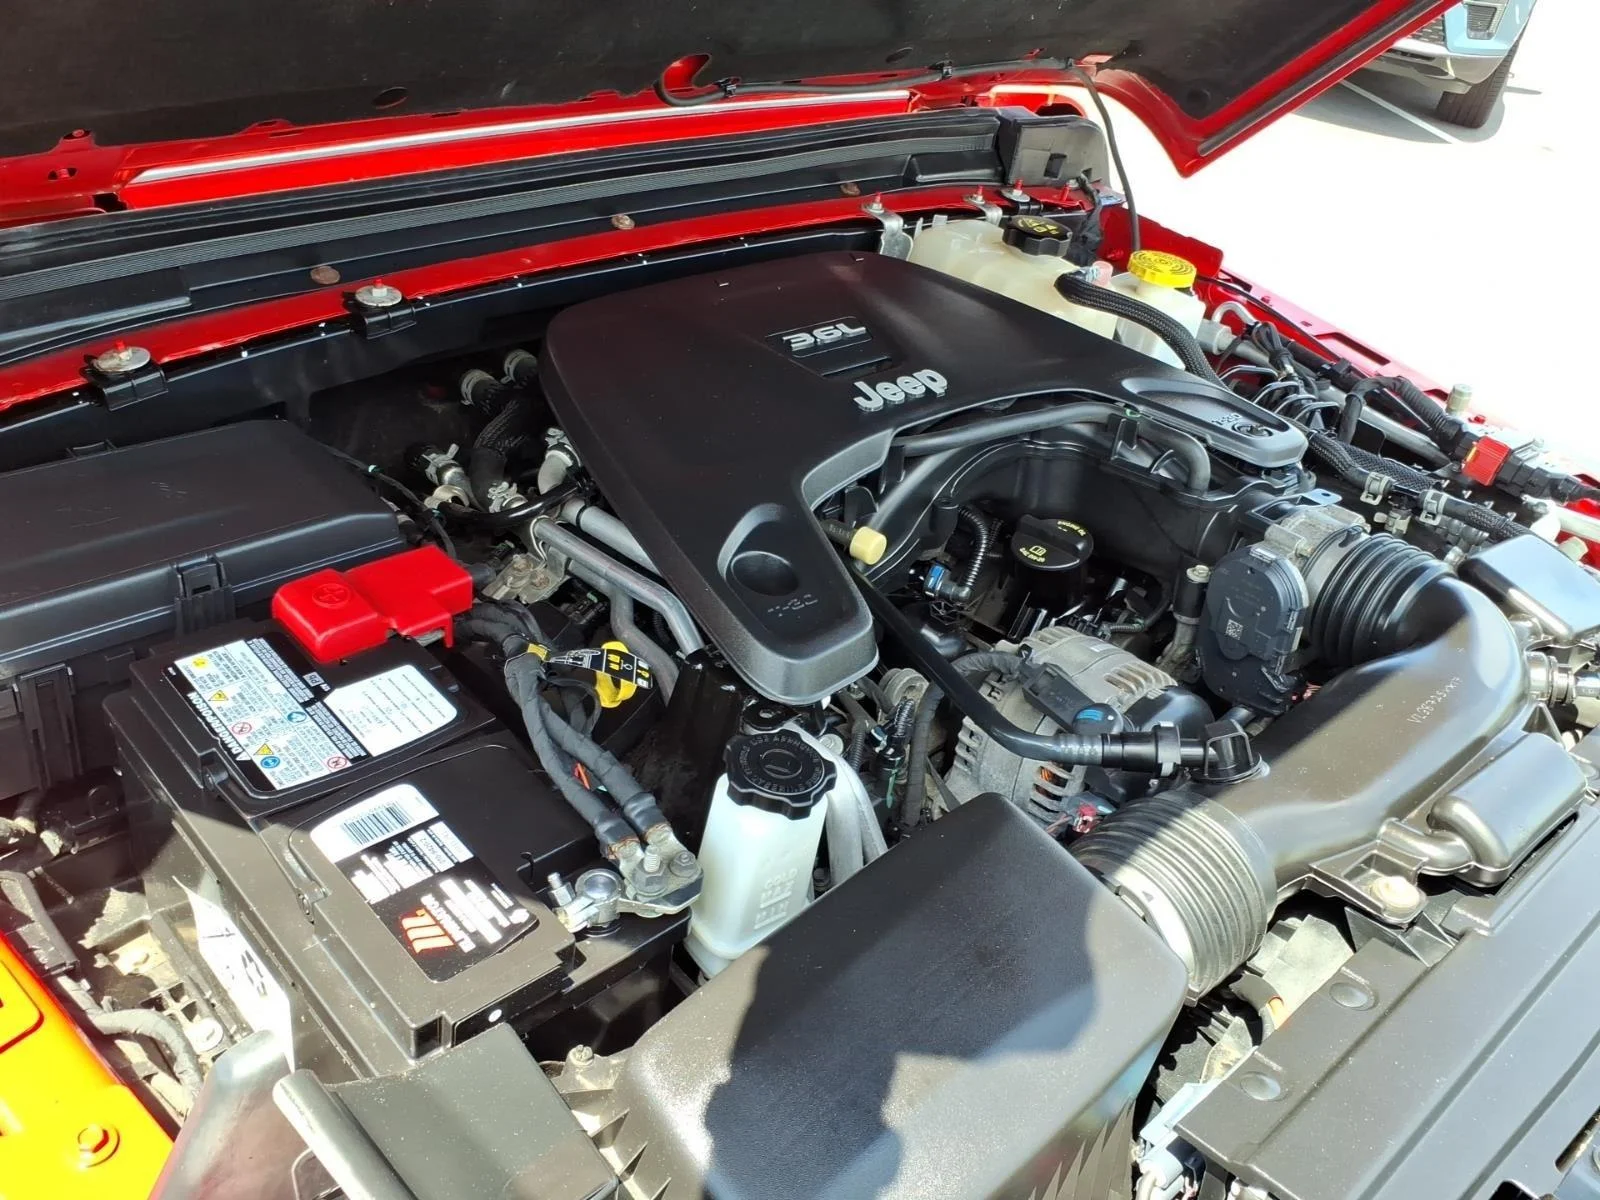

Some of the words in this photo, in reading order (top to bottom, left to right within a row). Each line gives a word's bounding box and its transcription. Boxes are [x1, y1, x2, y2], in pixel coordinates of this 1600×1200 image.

[782, 322, 867, 351] 3.6L
[853, 368, 948, 412] Jeep
[187, 691, 243, 755] DANGER/POISON
[764, 867, 798, 889] COLD
[420, 893, 477, 953] ELIMINATOR
